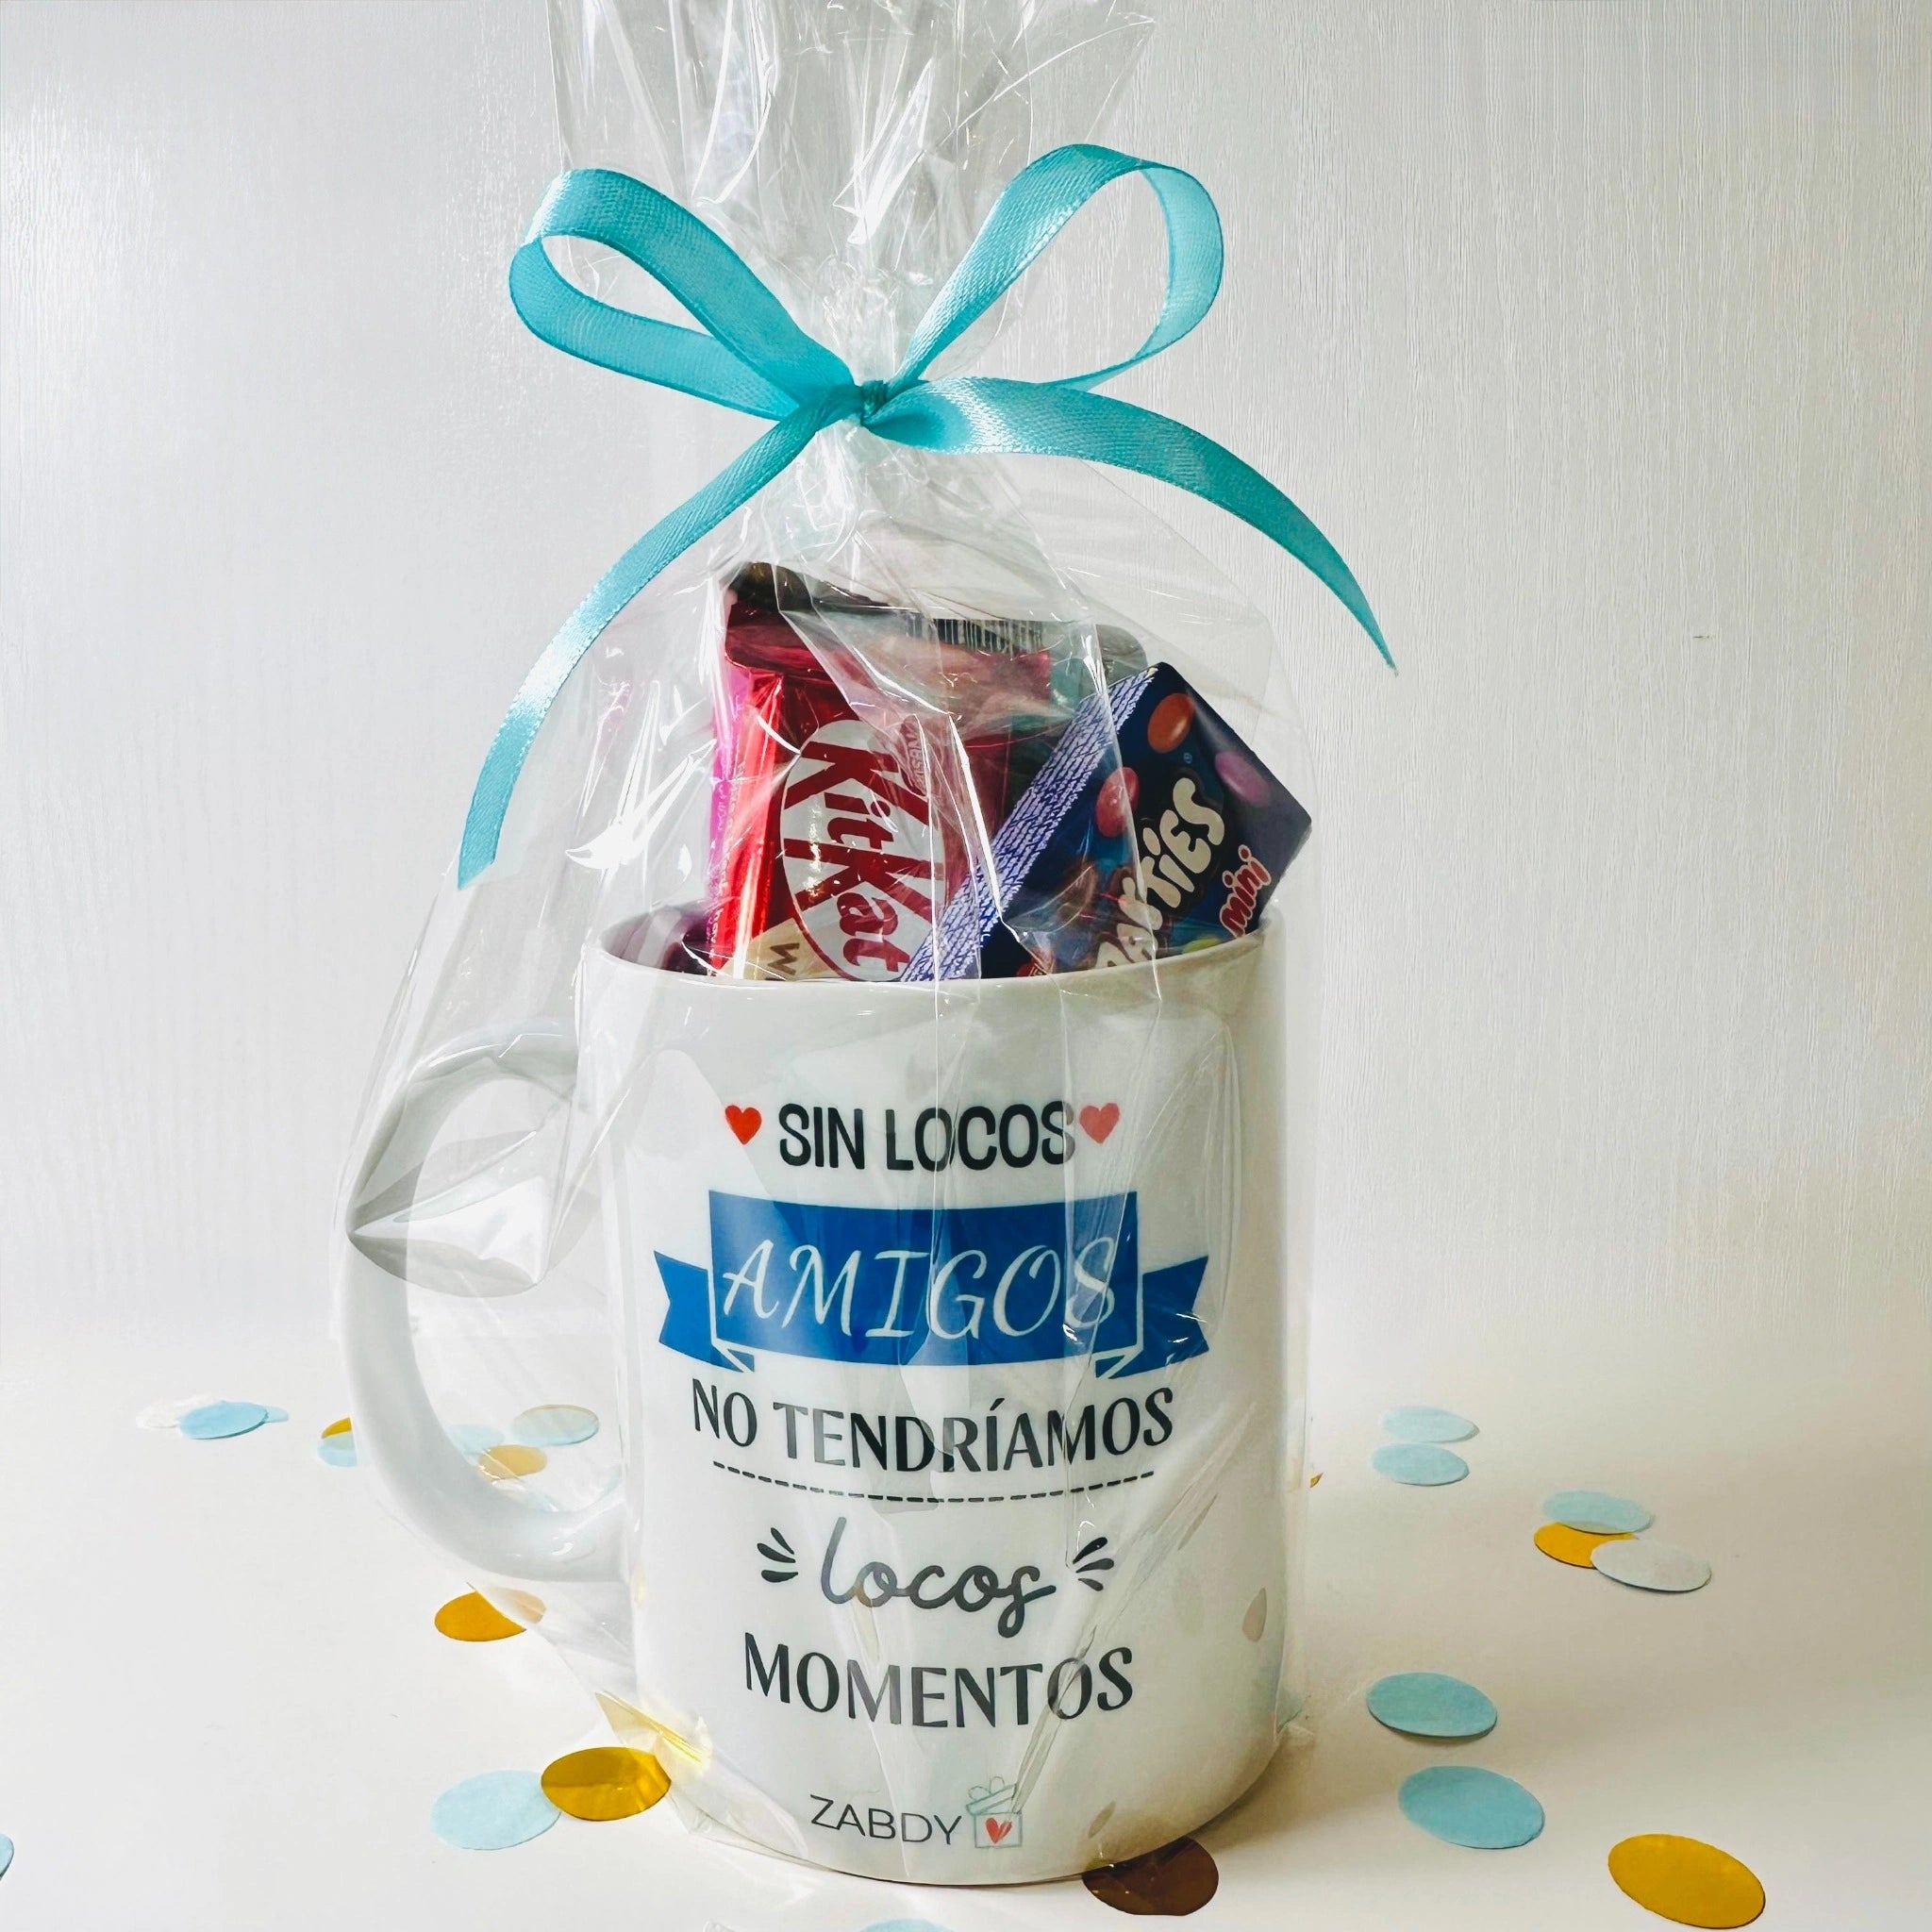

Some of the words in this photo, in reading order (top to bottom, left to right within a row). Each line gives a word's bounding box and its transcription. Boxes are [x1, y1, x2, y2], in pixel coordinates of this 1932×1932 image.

[784, 741, 943, 973] KitKat
[1219, 844, 1272, 939] mini
[779, 1104, 864, 1169] SIN
[886, 1100, 1076, 1172] LOCOS
[723, 1238, 1116, 1340] AMIGOS
[692, 1378, 757, 1448] NO
[773, 1388, 1174, 1473] TENDRÍAMOS
[821, 1516, 1057, 1638] locos
[745, 1632, 1133, 1727] MOMENTOS
[809, 1793, 962, 1845] ZABDY
